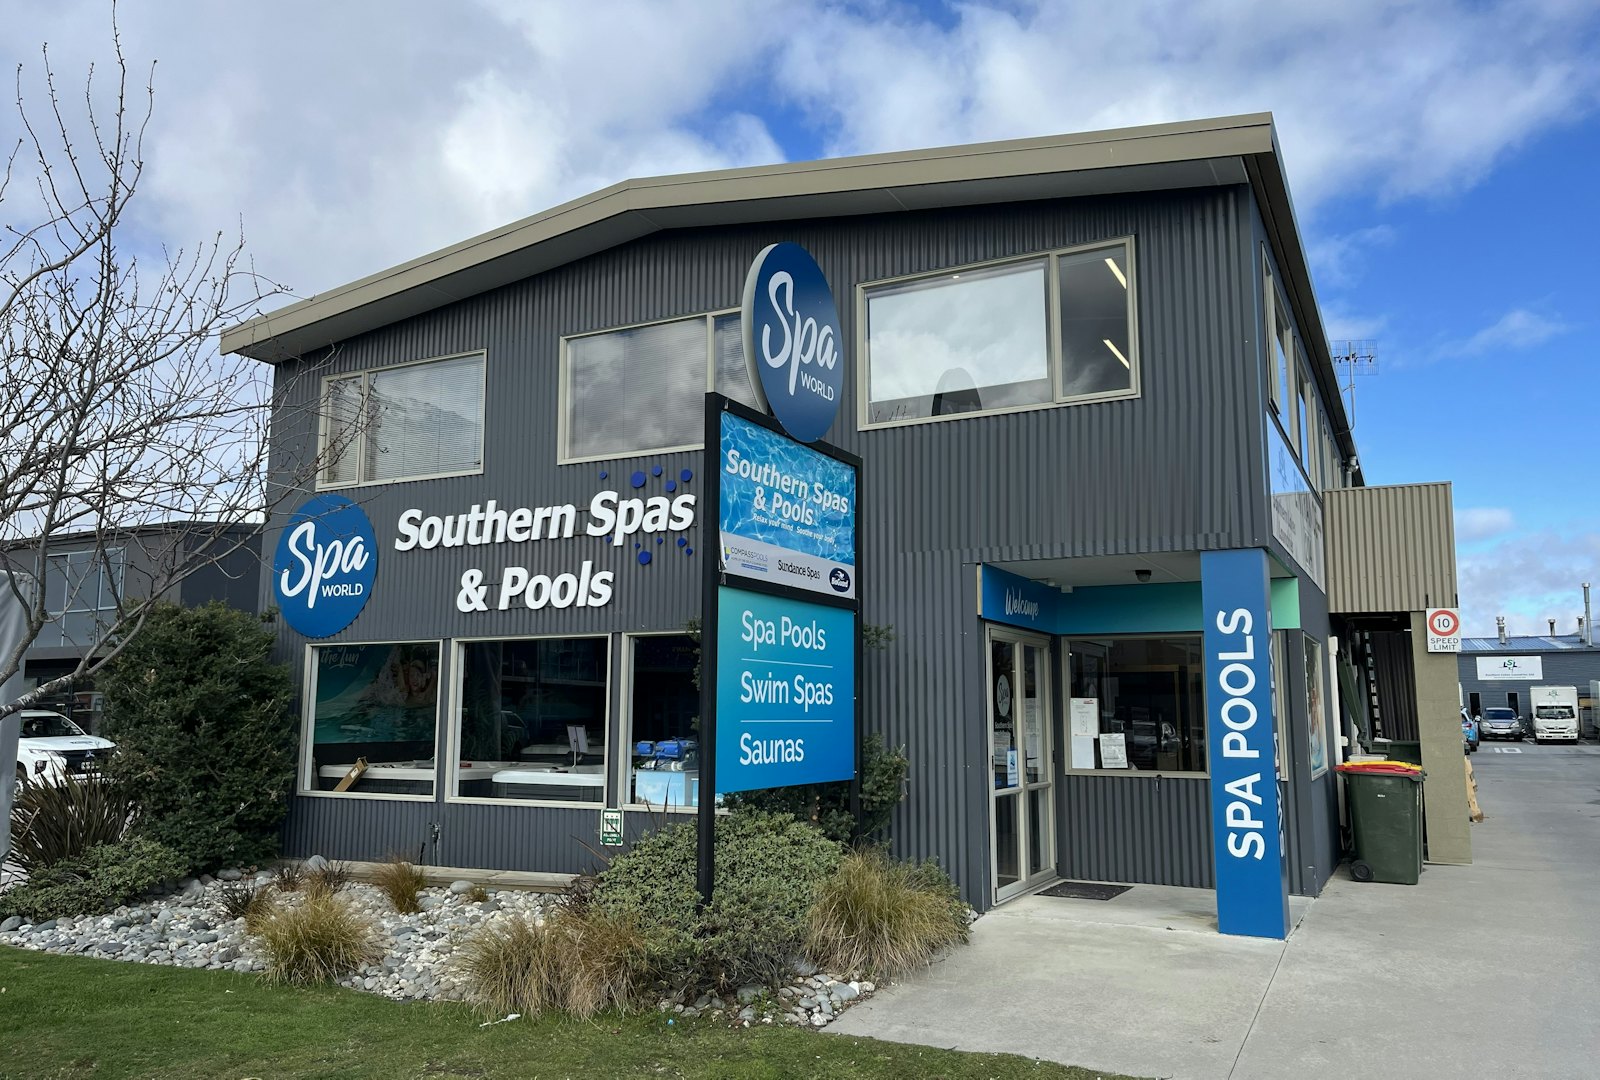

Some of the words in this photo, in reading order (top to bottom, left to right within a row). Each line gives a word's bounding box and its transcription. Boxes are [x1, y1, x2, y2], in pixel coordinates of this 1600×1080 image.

[762, 271, 837, 396] Spa
[801, 370, 834, 401] WORLD
[725, 449, 808, 500] Southern
[813, 482, 849, 514] Spas
[394, 500, 576, 551] Southern
[586, 490, 696, 546] Spas
[753, 486, 766, 511] &
[771, 492, 814, 525] Pools
[281, 521, 369, 609] Spa
[777, 559, 806, 576] Sundance
[807, 566, 820, 580] Spas
[322, 583, 363, 597] WORLD
[456, 568, 488, 613] &
[498, 560, 614, 611] Pools
[1005, 587, 1039, 621] Welcome
[741, 610, 776, 651] Spa
[781, 615, 826, 651] Pools
[1437, 618, 1450, 628] 10
[740, 670, 789, 704] Swim
[793, 674, 833, 713] Spas
[1216, 608, 1260, 759] POOLS
[739, 732, 804, 766] Saunas
[1225, 772, 1265, 861] SPA
